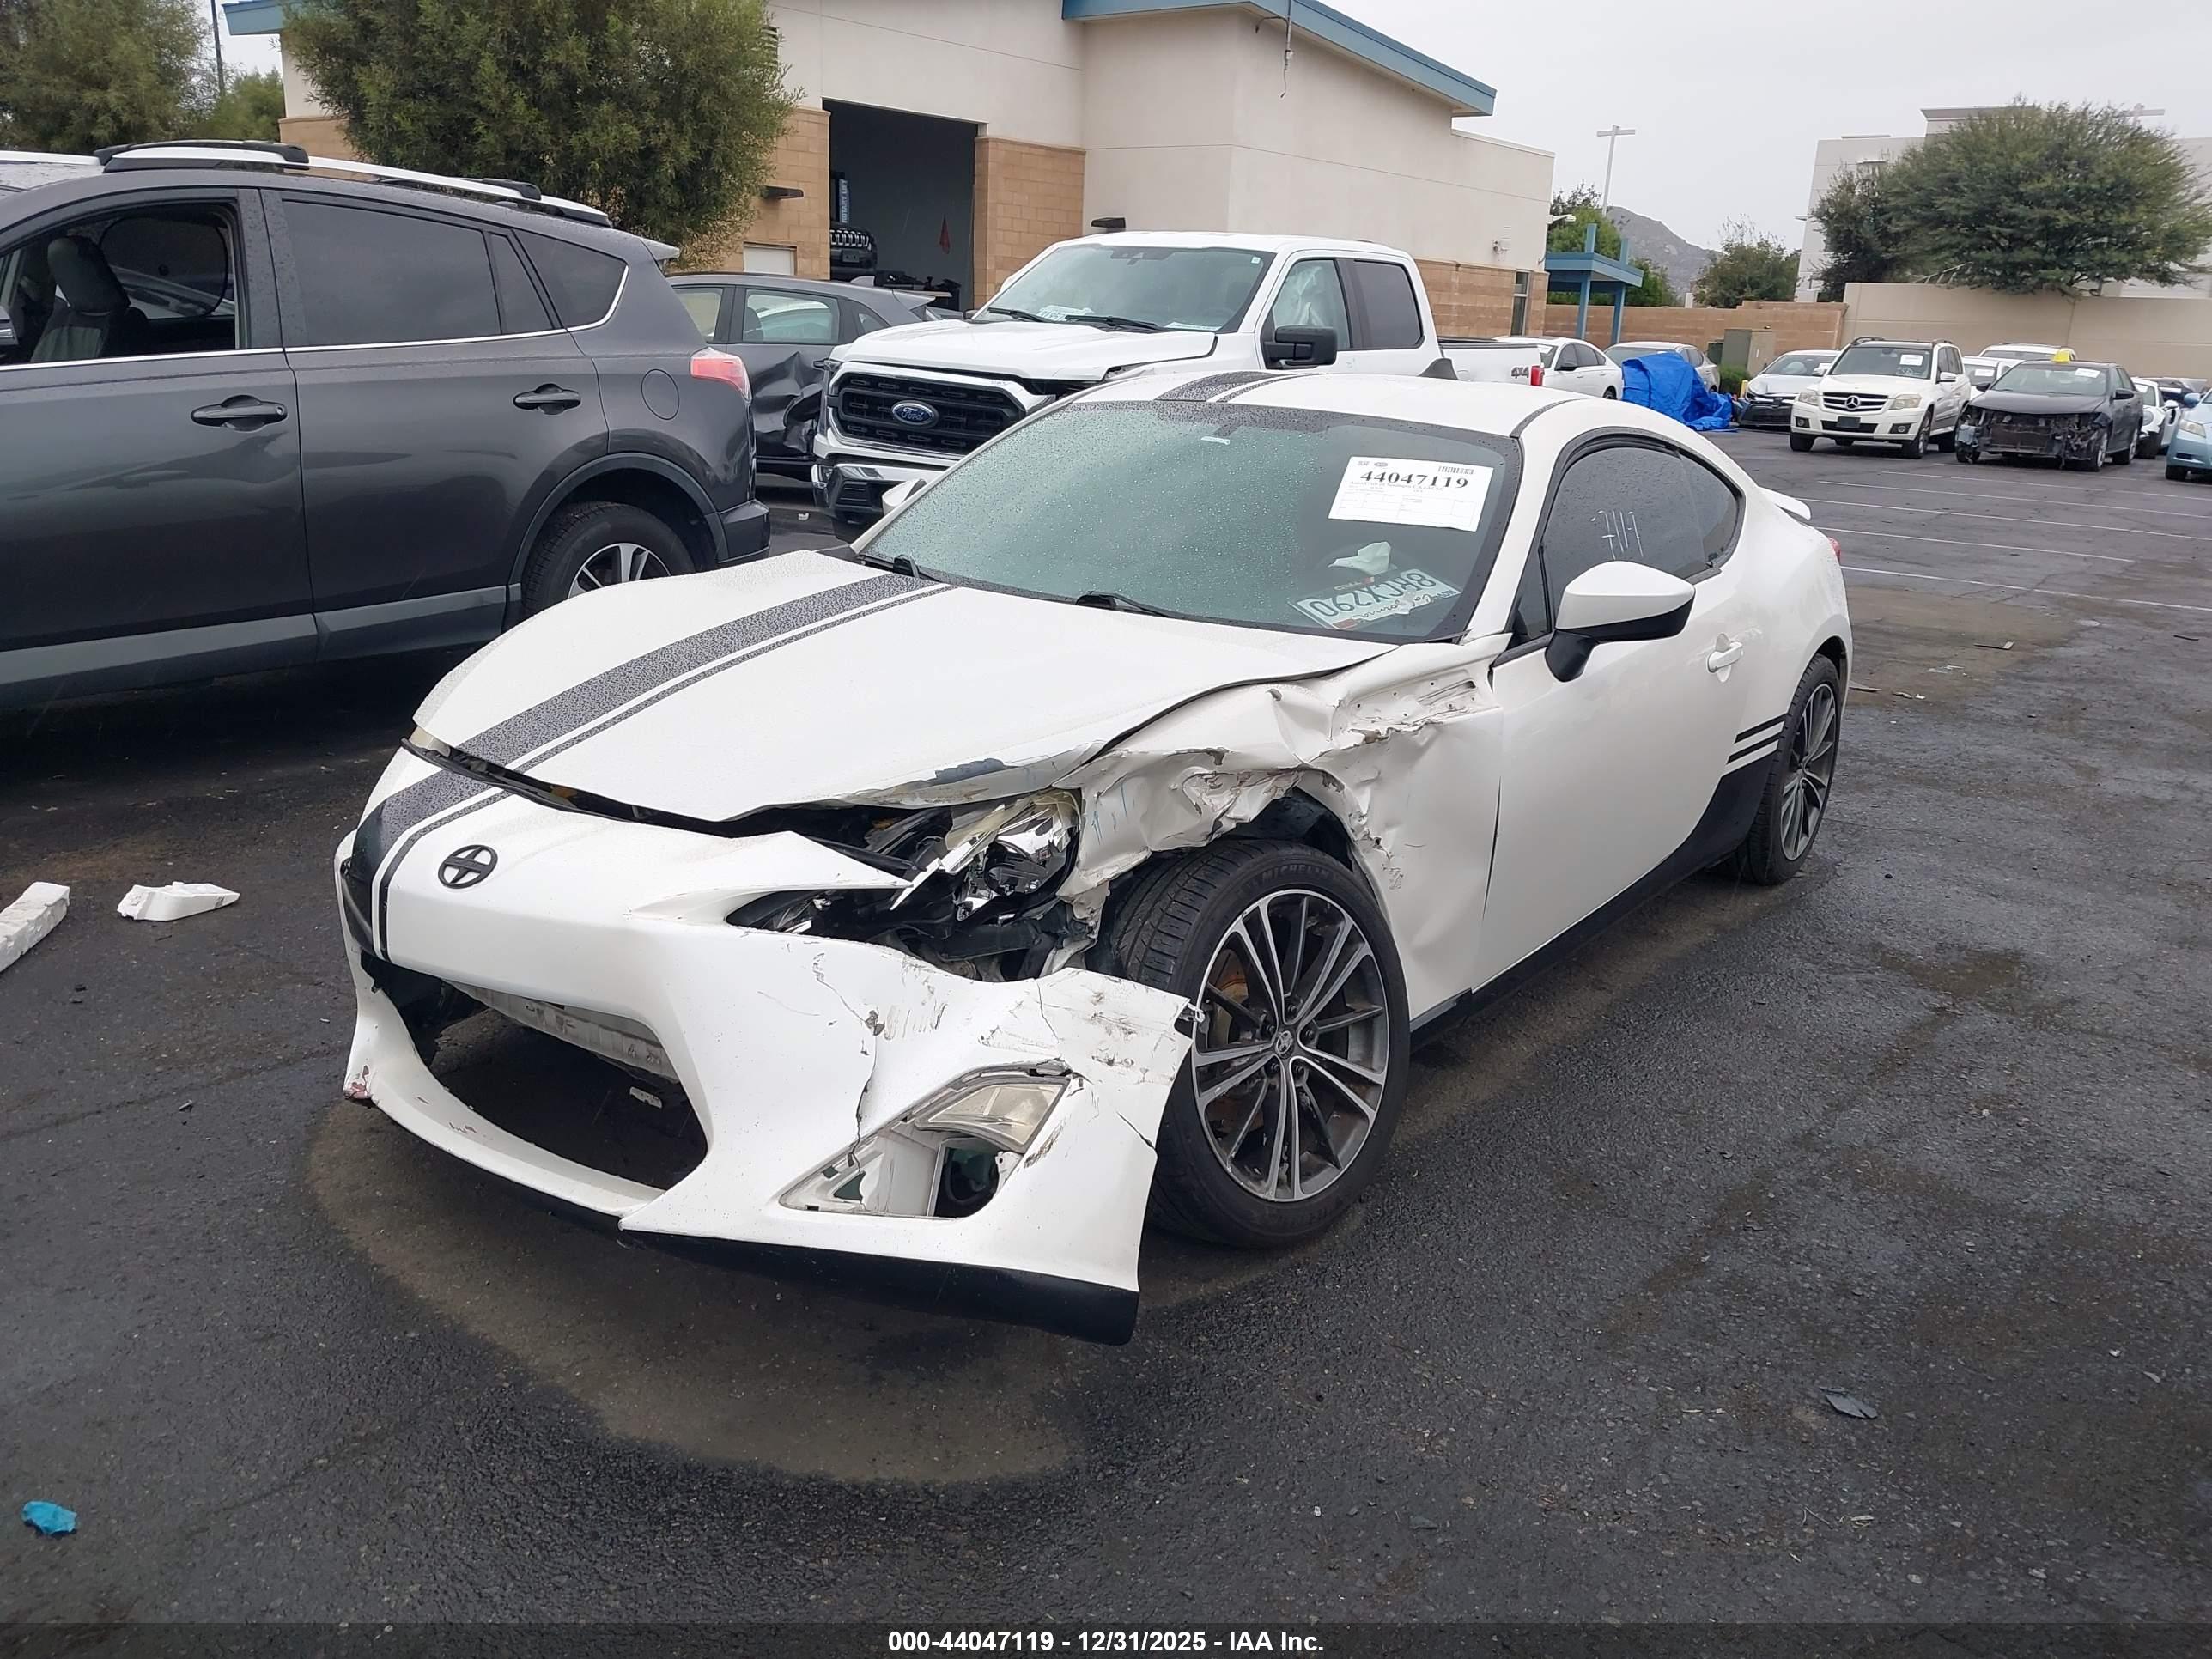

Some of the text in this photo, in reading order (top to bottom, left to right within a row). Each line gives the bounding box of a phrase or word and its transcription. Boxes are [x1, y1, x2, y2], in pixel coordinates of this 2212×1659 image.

[901, 407, 924, 421] Ford
[1360, 471, 1469, 489] 44047119
[1261, 864, 1330, 882] MICHELIN
